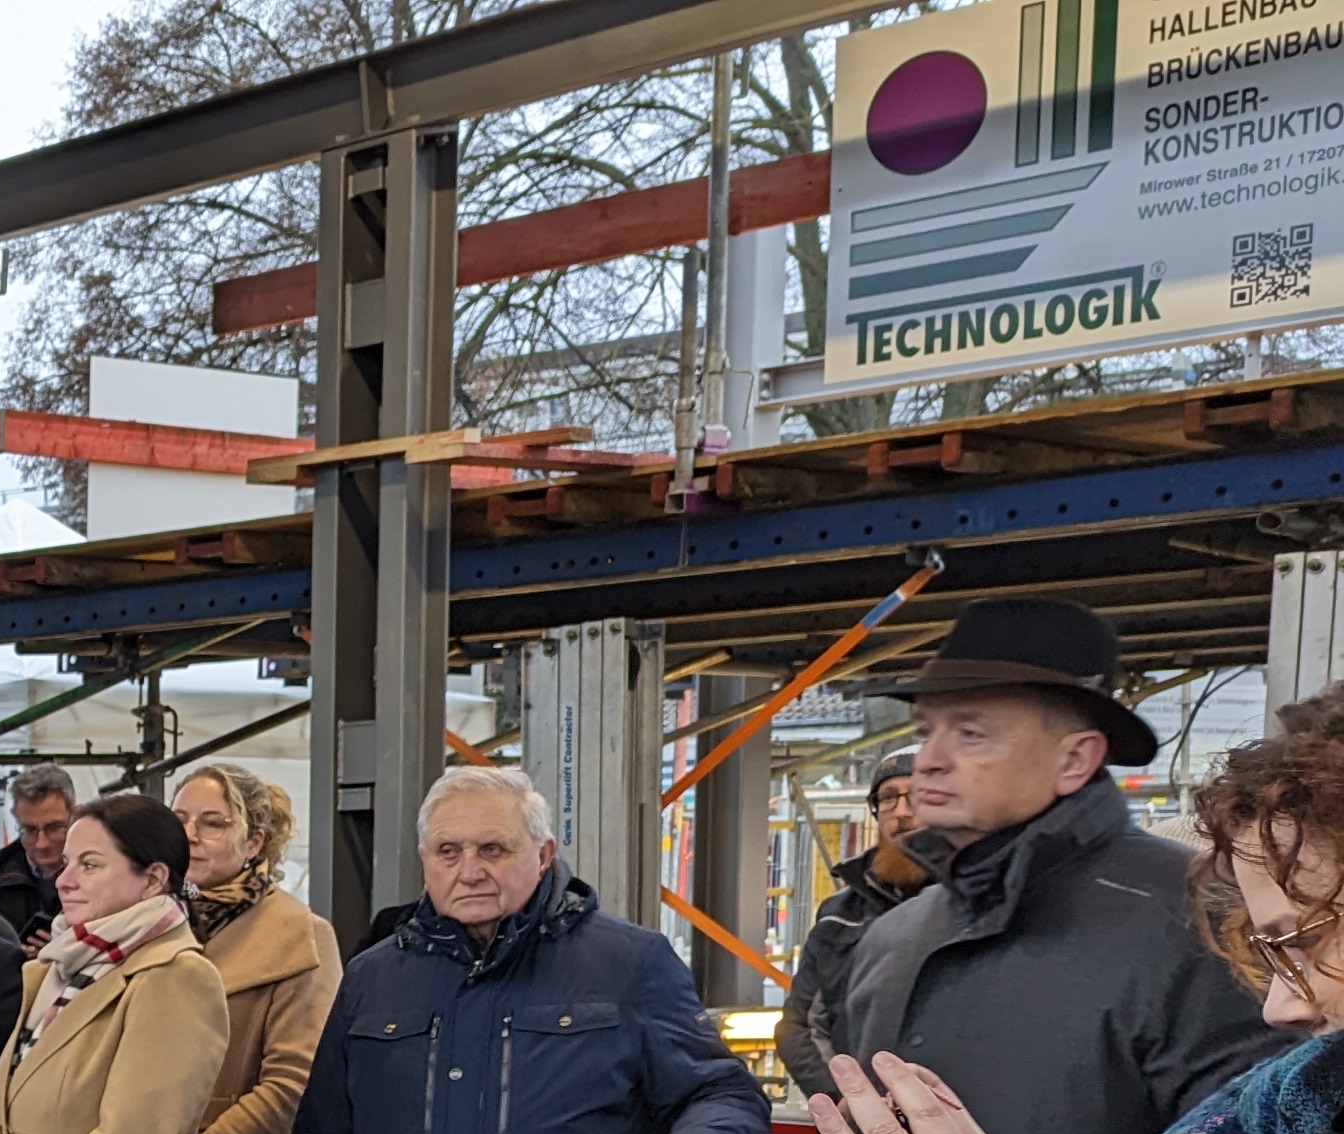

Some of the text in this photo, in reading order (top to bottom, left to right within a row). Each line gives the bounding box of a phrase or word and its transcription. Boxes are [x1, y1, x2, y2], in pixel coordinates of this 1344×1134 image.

[1147, 21, 1344, 88] BRÜCKENBAU
[1144, 87, 1269, 133] SONDER-
[1139, 173, 1202, 195] Mirower
[1206, 162, 1259, 182] Straße
[1263, 156, 1281, 172] 21
[845, 264, 1162, 366] TECHNOLOGIK
